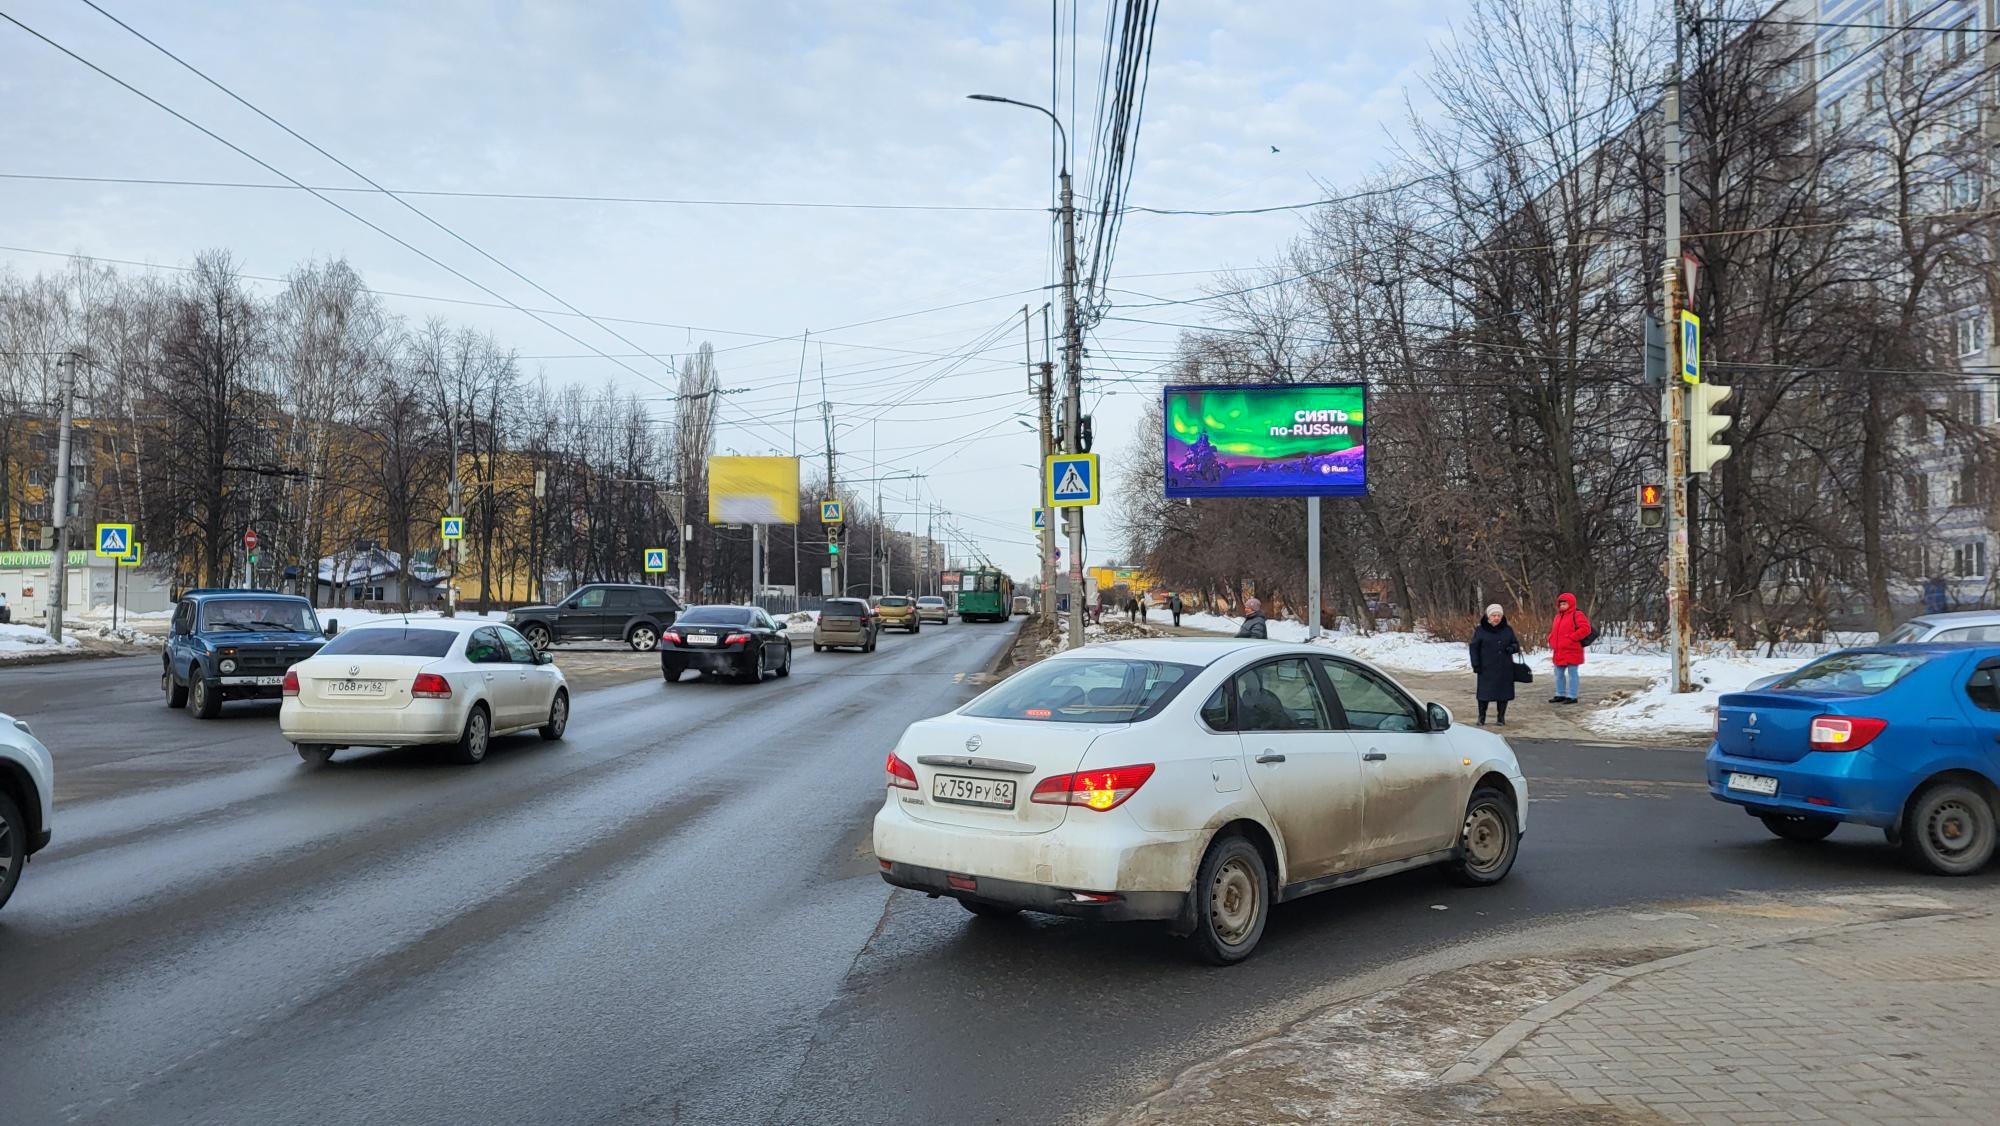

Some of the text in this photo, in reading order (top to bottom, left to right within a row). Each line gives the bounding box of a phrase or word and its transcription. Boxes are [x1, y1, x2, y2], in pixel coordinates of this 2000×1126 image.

[1295, 410, 1348, 422] СИЯТЬ
[1270, 424, 1348, 436] по-RUSSки
[1331, 465, 1348, 473] Russ
[0, 553, 31, 566] СНОЙ
[994, 782, 1010, 798] 62
